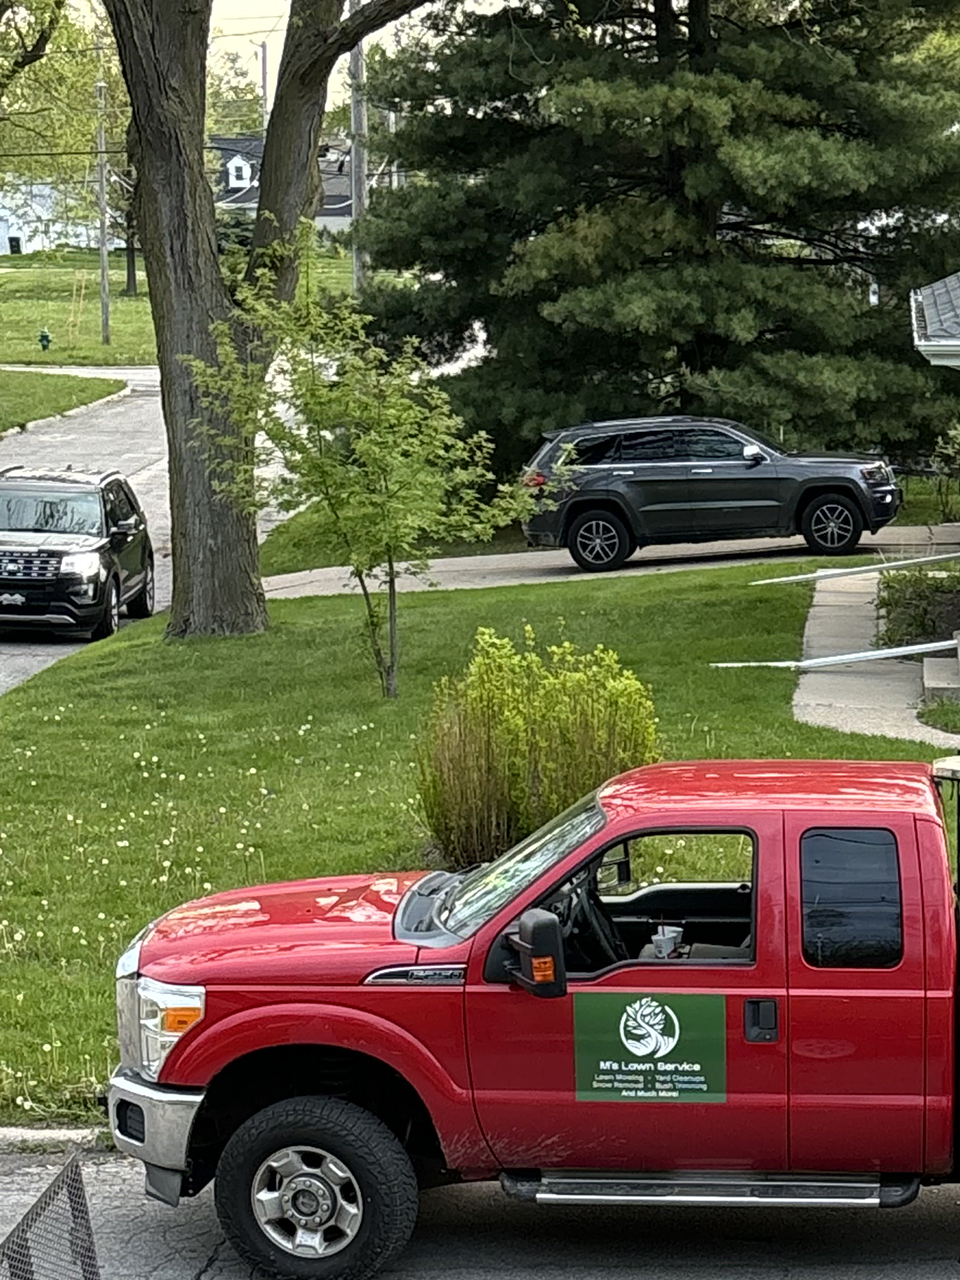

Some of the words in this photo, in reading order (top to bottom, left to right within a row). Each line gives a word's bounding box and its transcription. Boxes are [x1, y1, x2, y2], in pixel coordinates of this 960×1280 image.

[621, 1061, 655, 1070] Lawn
[657, 1061, 701, 1071] Service
[615, 1073, 644, 1082] Mowing
[672, 1074, 706, 1083] Cleanups
[675, 1083, 707, 1091] Trimming
